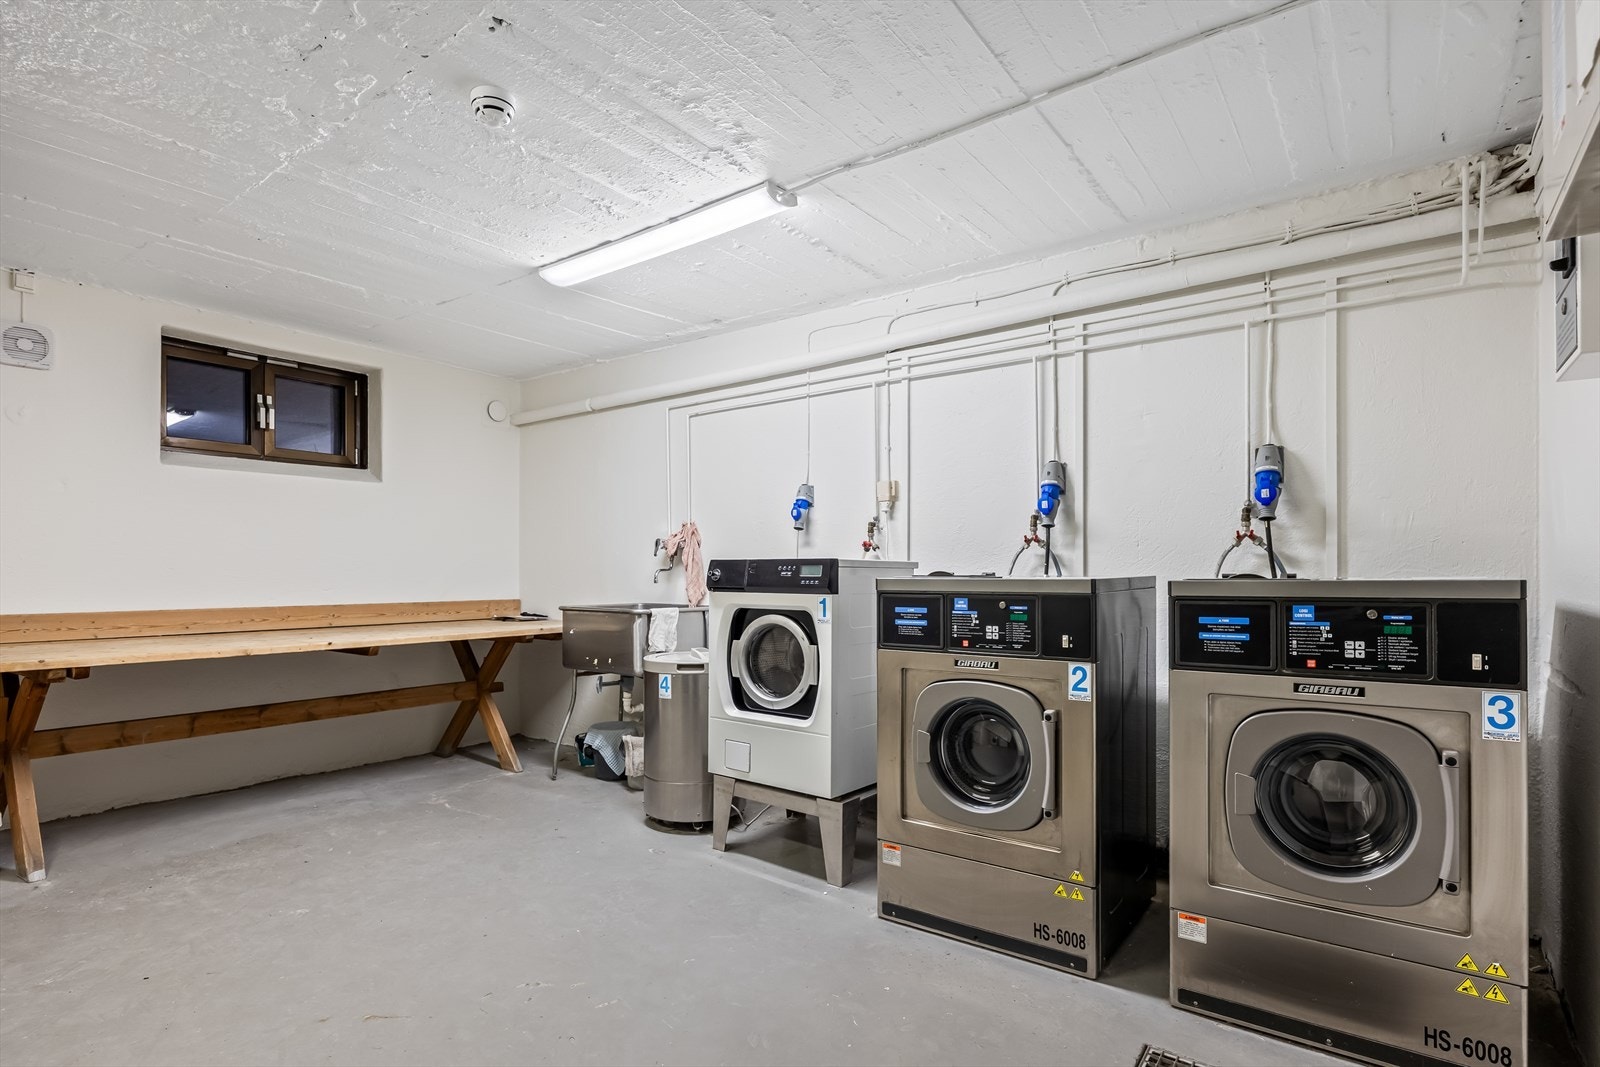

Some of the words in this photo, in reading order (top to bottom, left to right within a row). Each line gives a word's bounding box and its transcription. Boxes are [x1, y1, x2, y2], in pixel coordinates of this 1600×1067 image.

[819, 597, 827, 618] 1
[660, 676, 670, 693] 4
[1072, 666, 1088, 692] 2
[1298, 684, 1360, 696] GIRBAU
[1487, 695, 1516, 730] 3
[1033, 922, 1086, 950] HS-6008
[1424, 1026, 1512, 1067] HS-6008
